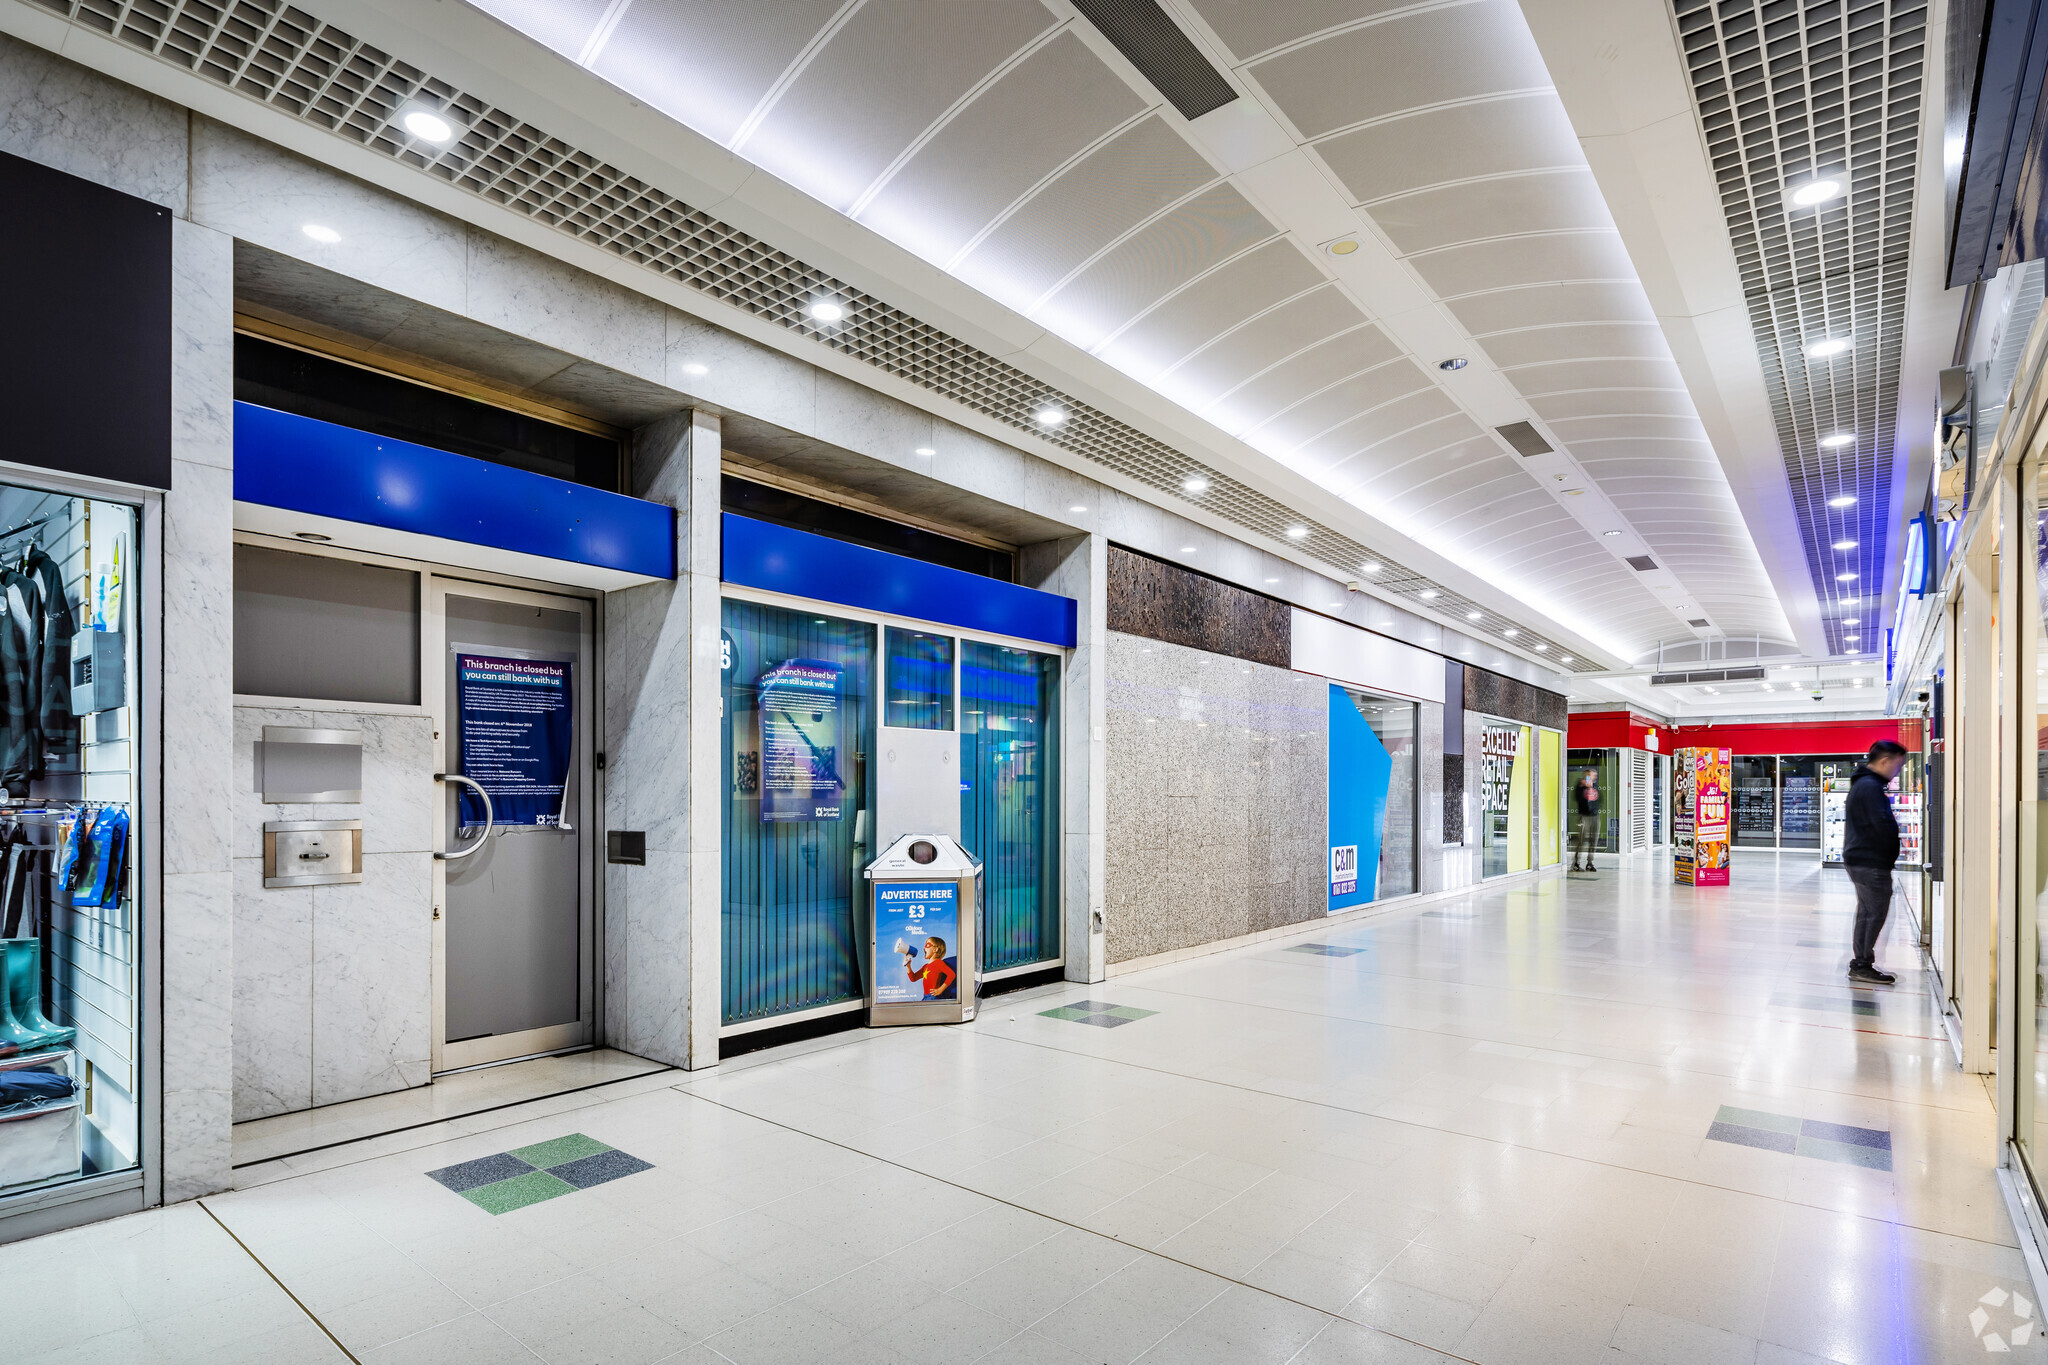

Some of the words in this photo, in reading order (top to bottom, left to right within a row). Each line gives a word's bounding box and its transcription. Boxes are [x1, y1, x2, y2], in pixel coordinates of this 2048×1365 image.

[465, 659, 483, 669] This
[484, 661, 514, 671] branch
[523, 665, 549, 674] closed
[550, 667, 563, 675] but
[465, 672, 481, 680] you
[498, 673, 511, 681] still
[512, 674, 532, 683] bank
[533, 676, 550, 684] with
[762, 672, 776, 680] This
[808, 670, 826, 679] closed
[762, 678, 776, 686] you
[1482, 726, 1525, 758] EXCELLENT
[1482, 754, 1509, 783] RETAIL
[1676, 771, 1694, 790] Gold
[1482, 783, 1508, 810] SPACE
[1700, 804, 1725, 818] FUN
[1335, 848, 1354, 872] c&m
[881, 890, 929, 900] ADVERTISE
[930, 890, 952, 898] HERE
[909, 905, 925, 918] £3
